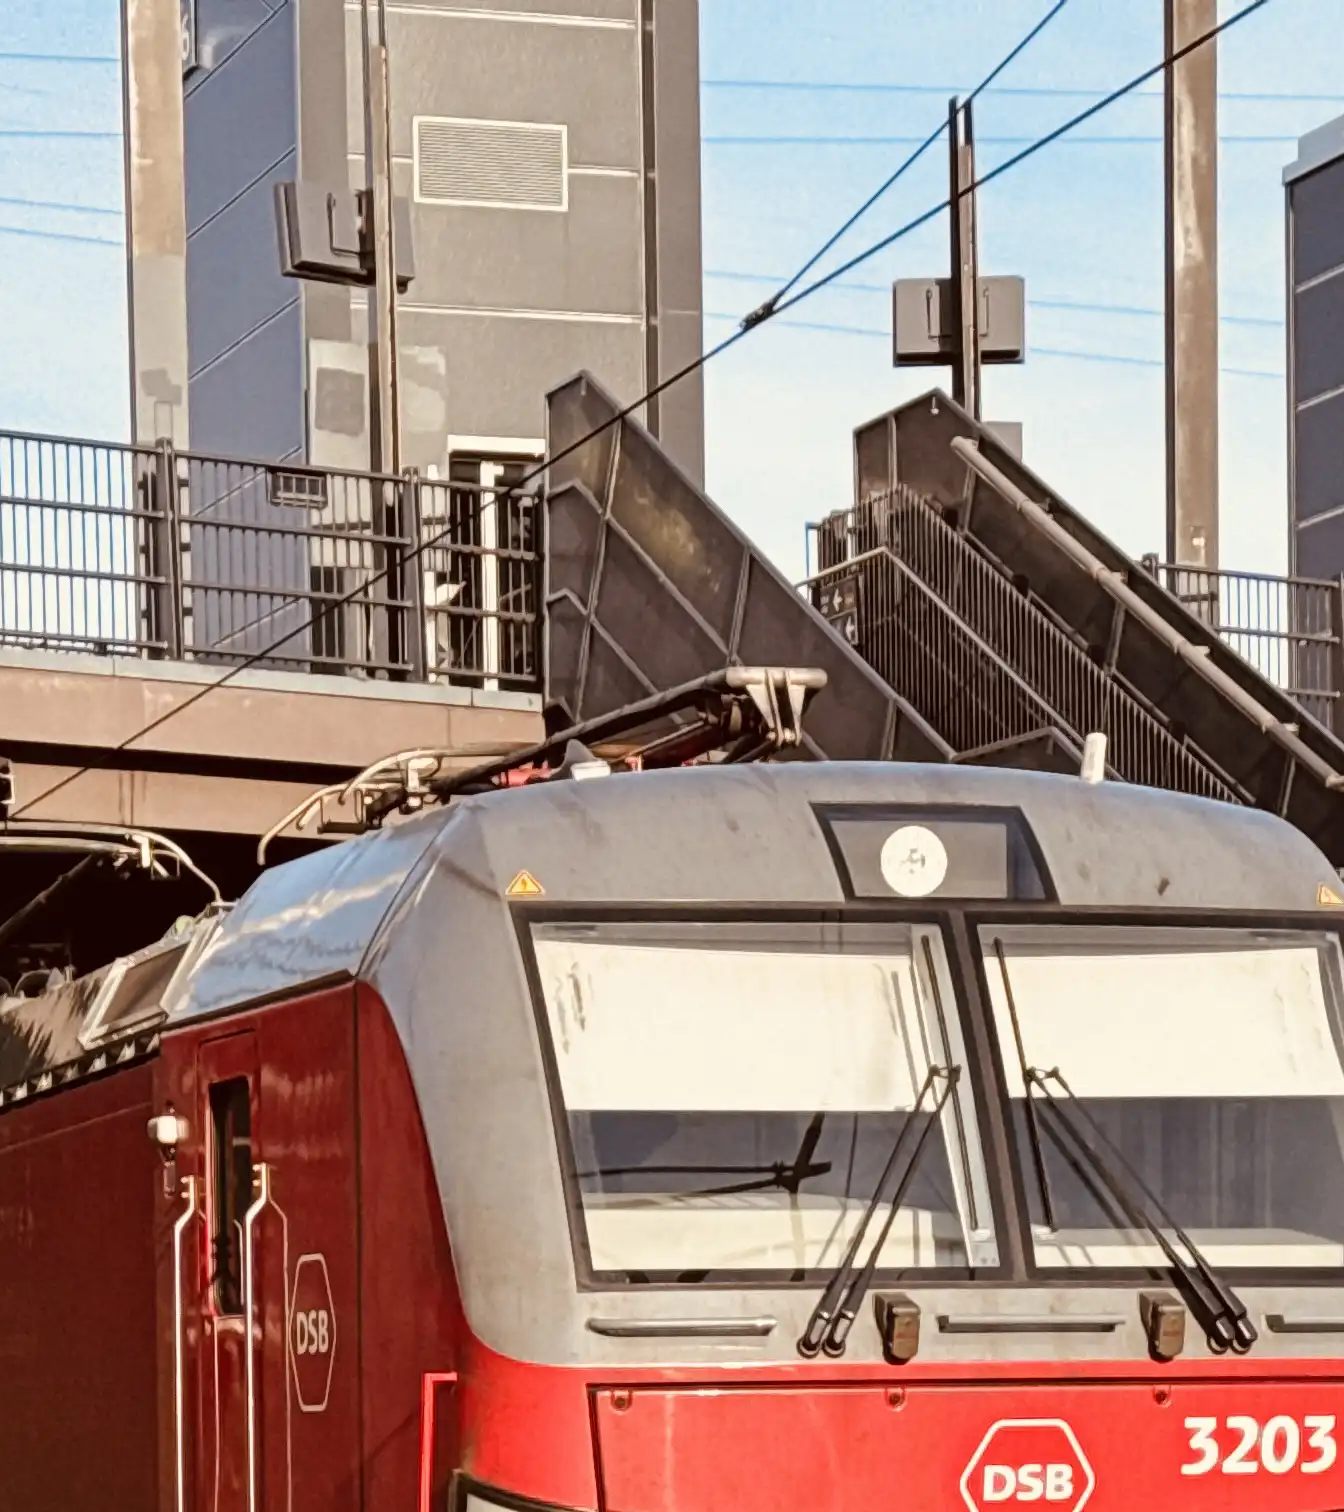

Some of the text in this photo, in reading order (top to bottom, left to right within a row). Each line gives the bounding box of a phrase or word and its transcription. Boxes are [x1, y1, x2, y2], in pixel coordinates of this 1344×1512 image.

[296, 1309, 329, 1355] DSB
[1180, 1414, 1337, 1476] 3203
[982, 1463, 1073, 1502] DSB
